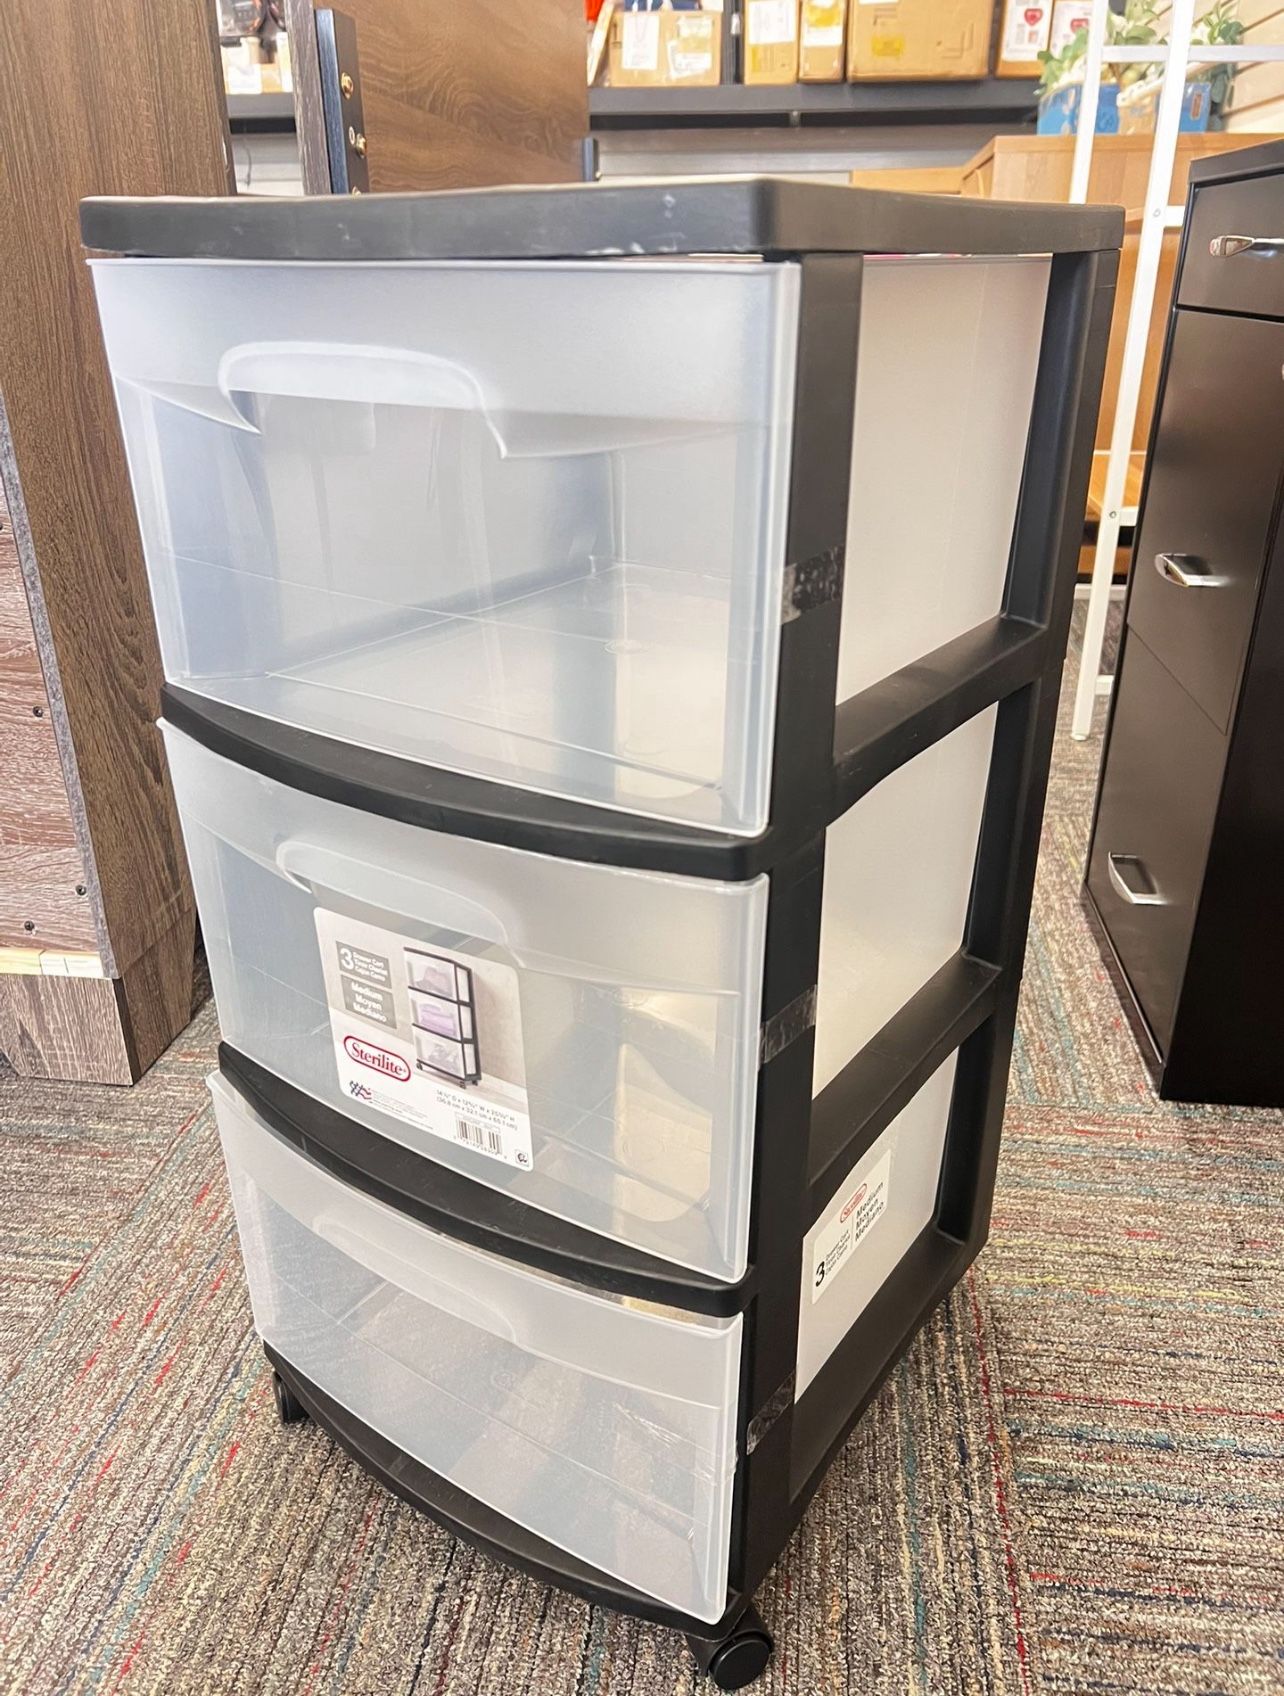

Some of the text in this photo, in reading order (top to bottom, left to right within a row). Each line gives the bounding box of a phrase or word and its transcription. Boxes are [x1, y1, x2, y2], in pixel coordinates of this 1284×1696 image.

[340, 948, 354, 970] 3
[351, 980, 383, 1001] Medium
[355, 993, 382, 1011] Moyen
[856, 1182, 883, 1219] Medium
[855, 1198, 878, 1230] Moyen
[815, 1260, 825, 1287] 3
